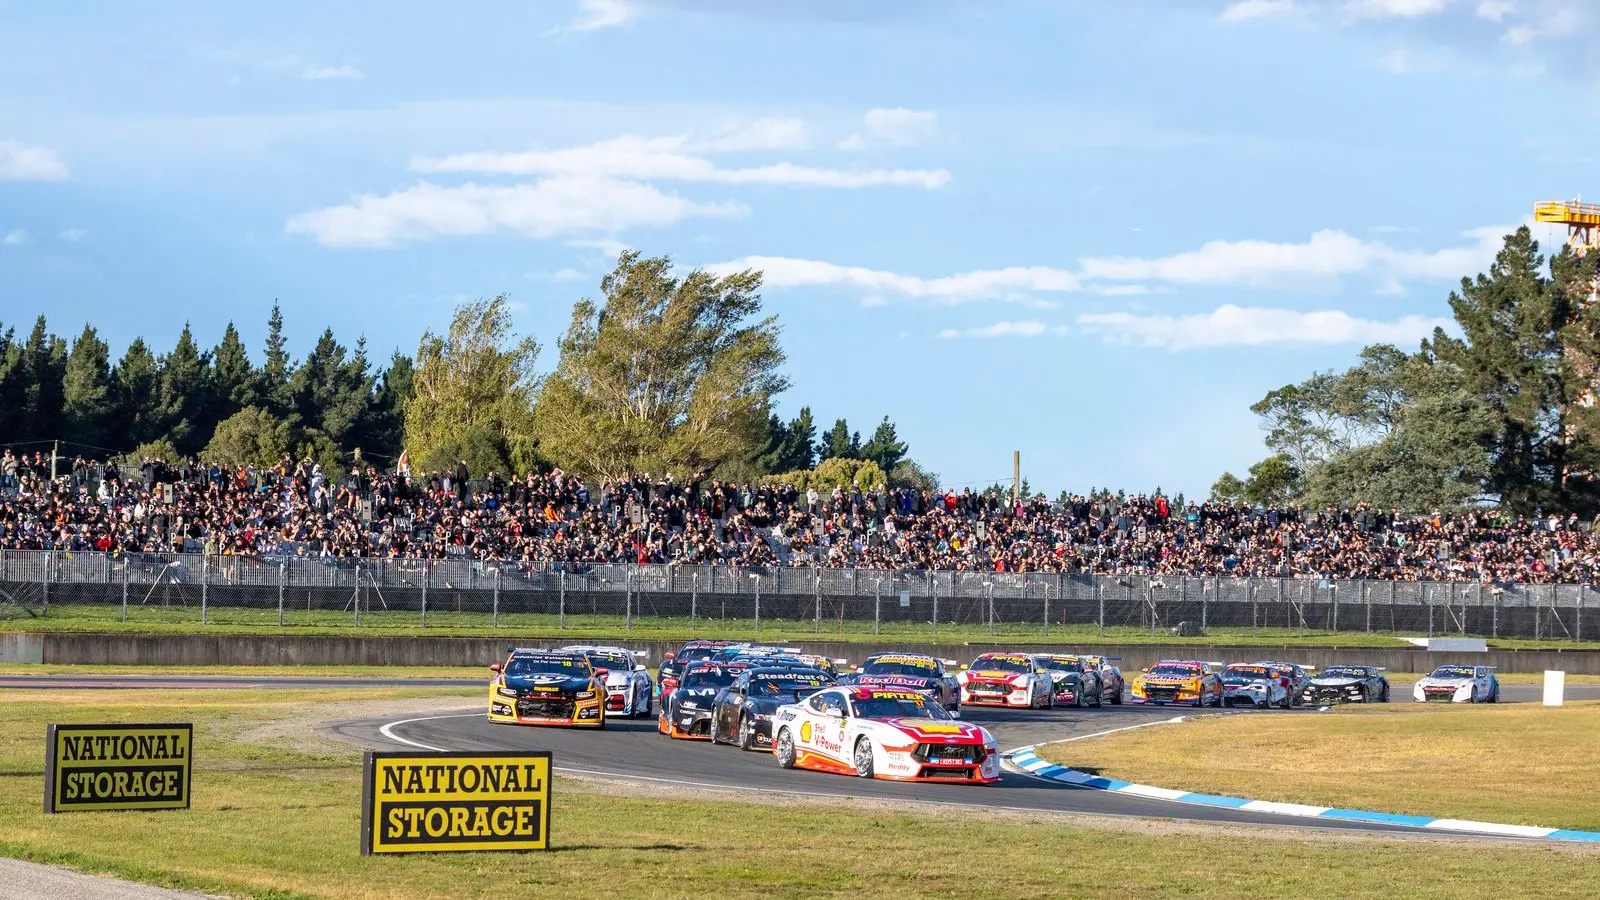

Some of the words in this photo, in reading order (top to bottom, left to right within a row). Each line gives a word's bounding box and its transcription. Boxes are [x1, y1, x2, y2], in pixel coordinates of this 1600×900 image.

[757, 673, 815, 681] Steadfast
[860, 676, 893, 685] Red
[893, 678, 928, 688] Bull
[873, 691, 926, 701] PIRTEK
[814, 723, 826, 733] Shell
[62, 735, 184, 761] NATIONAL
[814, 734, 842, 753] V-Power
[888, 763, 911, 772] Reddy
[66, 771, 178, 799] STORAGE
[382, 765, 542, 794] NATIONAL
[388, 806, 534, 839] STORAGE
